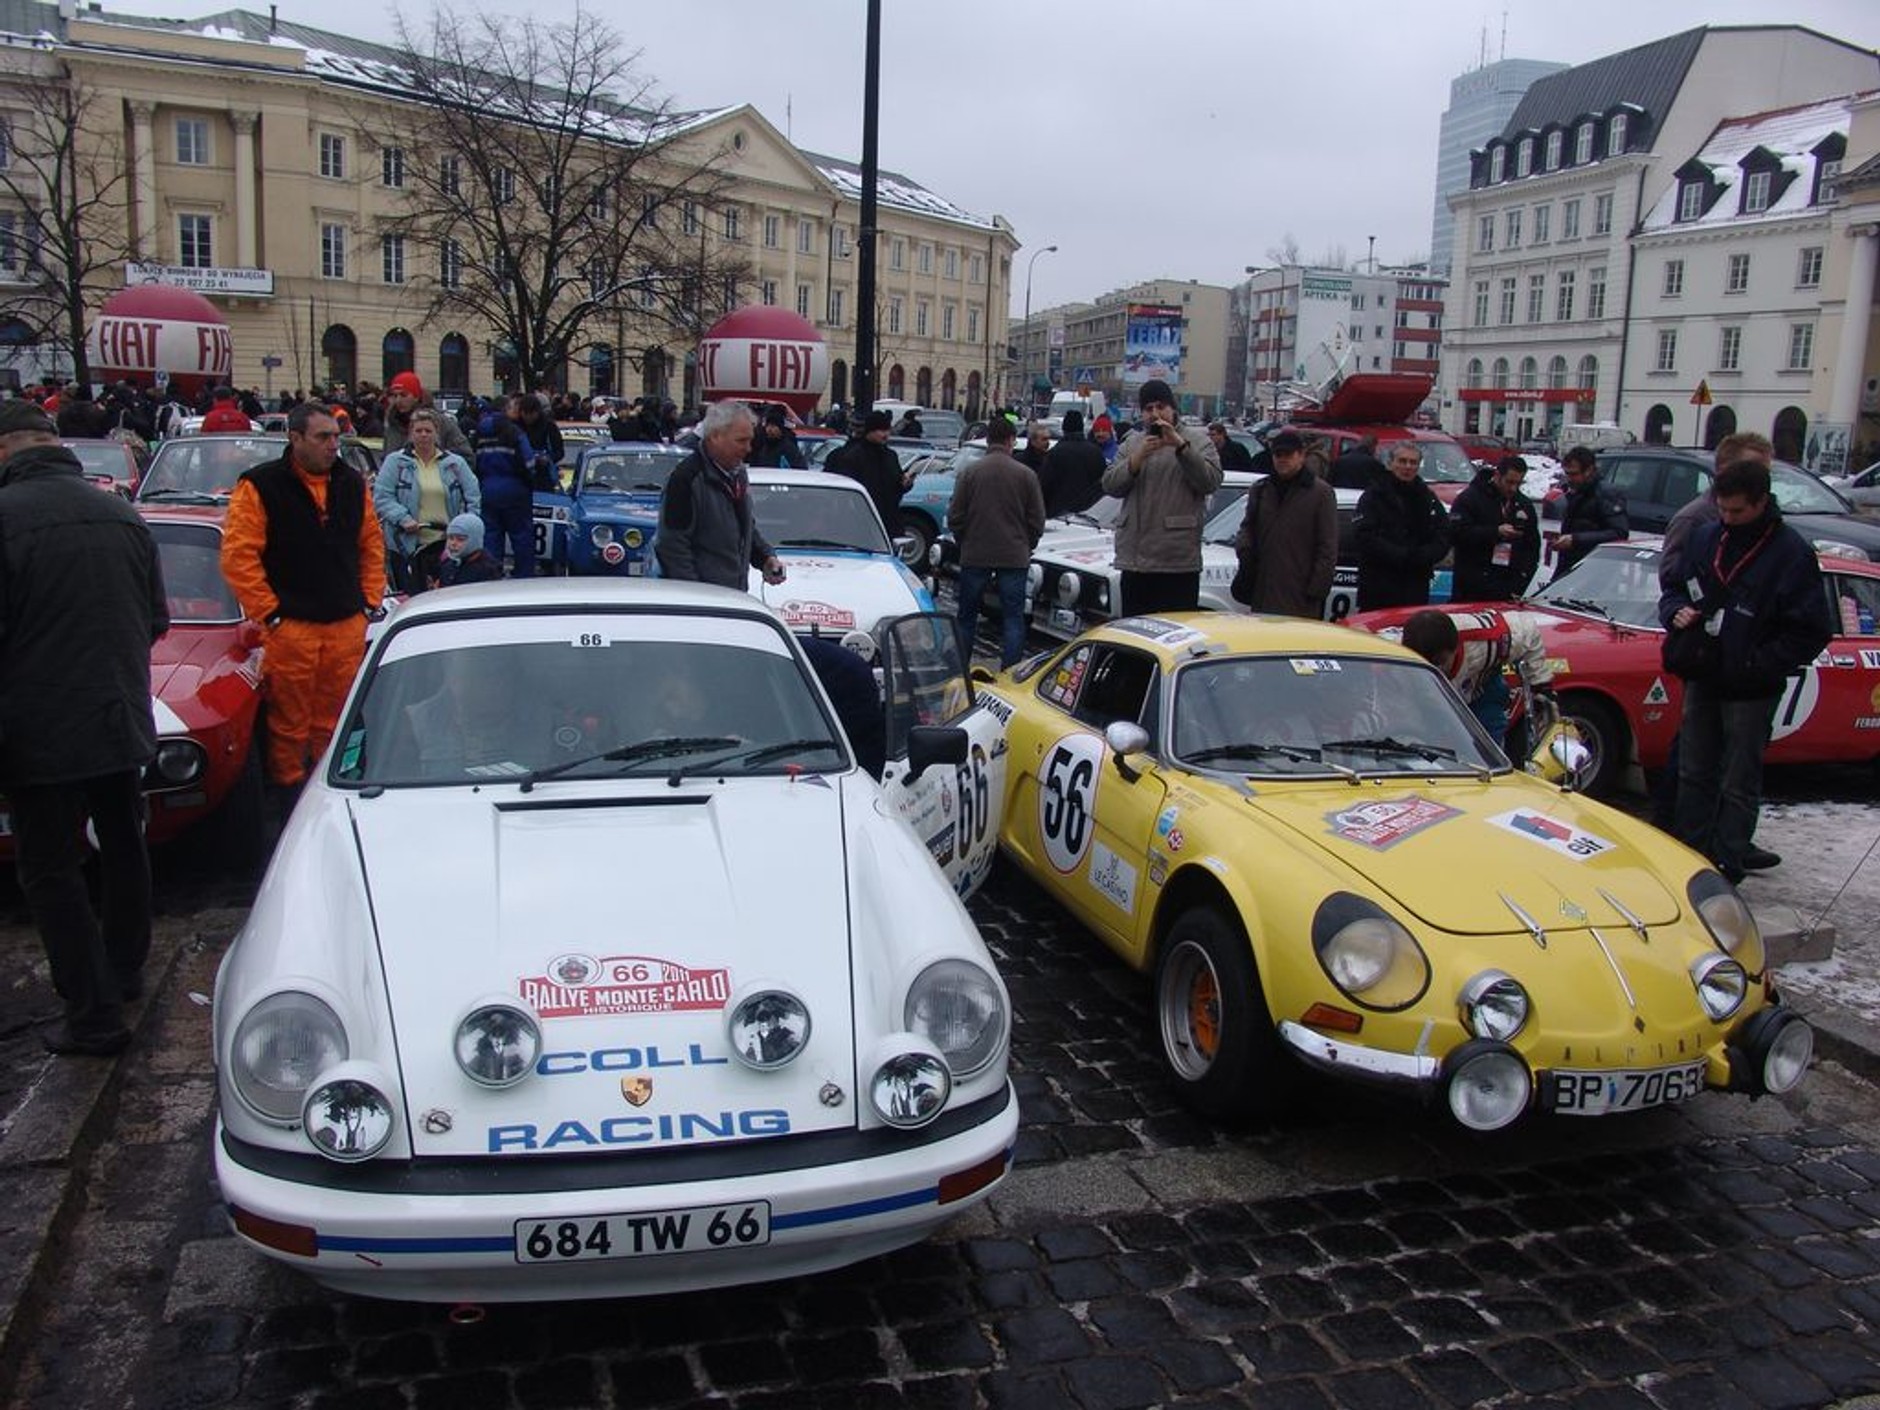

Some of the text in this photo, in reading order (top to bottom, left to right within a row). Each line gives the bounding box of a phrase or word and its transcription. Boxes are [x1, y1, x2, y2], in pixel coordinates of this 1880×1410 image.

[207, 269, 219, 278] DO
[100, 320, 163, 368] FIAT
[750, 343, 813, 390] FIAT
[580, 633, 602, 646] 66
[956, 744, 989, 860] 66
[1045, 746, 1093, 854] 56
[525, 972, 728, 1010] RALLYE MONTE-CARLO
[612, 962, 690, 983] 66 2011
[583, 1002, 672, 1015] HISTORIQUE
[536, 1044, 729, 1076] COLL
[1555, 1074, 1602, 1109] BP
[488, 1109, 791, 1151] RACING
[527, 1207, 761, 1259] 684 TW 66
